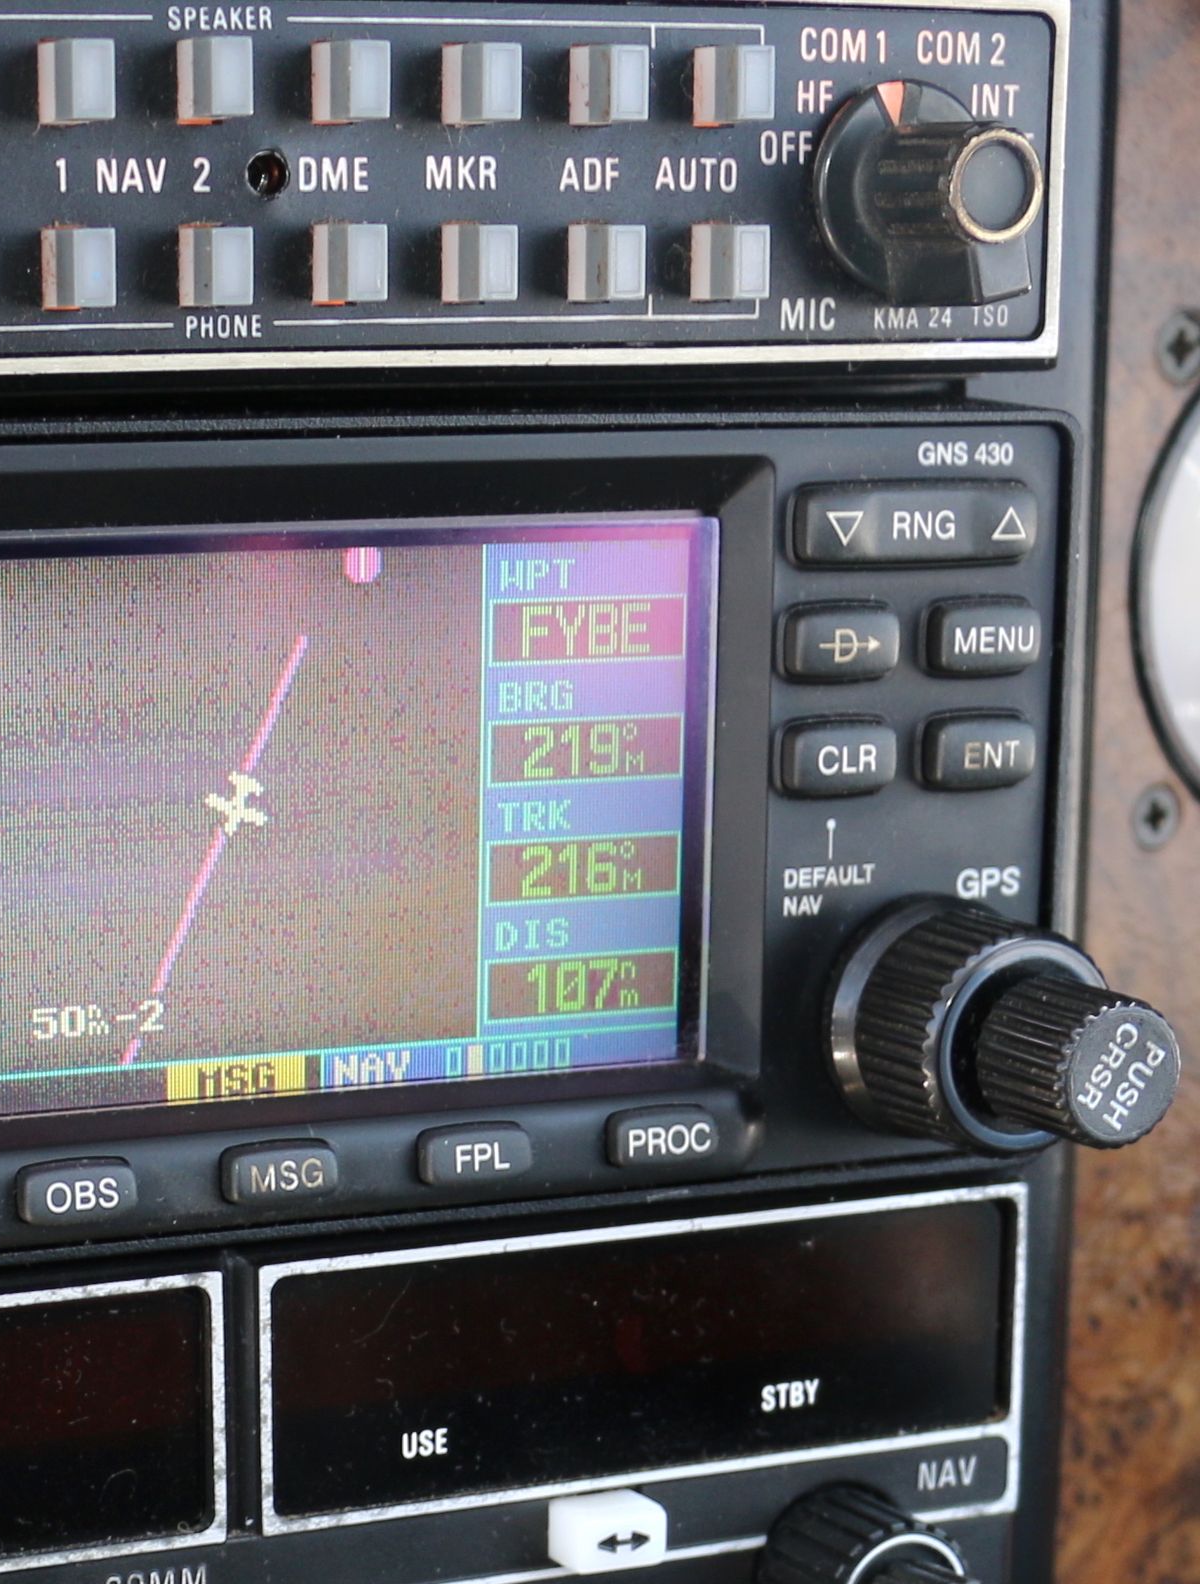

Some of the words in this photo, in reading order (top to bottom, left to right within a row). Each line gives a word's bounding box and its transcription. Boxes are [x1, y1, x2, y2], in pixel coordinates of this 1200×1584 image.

[168, 6, 273, 32] SPEAKER
[800, 27, 867, 63] COM
[877, 31, 888, 63] 1
[916, 31, 983, 64] COM
[989, 33, 1006, 64] 2
[797, 80, 834, 114] HF
[971, 83, 1020, 117] INT
[760, 131, 813, 165] OFF
[55, 158, 68, 192] 1
[96, 158, 167, 193] NAV
[192, 158, 212, 192] 2
[299, 157, 369, 192] DME
[425, 156, 498, 190] MKR
[560, 158, 620, 193] ADF
[655, 157, 738, 193] AUTO
[185, 315, 263, 339] PHONE
[780, 298, 836, 331] MIC
[873, 308, 918, 329] KMA
[929, 308, 952, 328] 24
[918, 441, 968, 467] GNS
[975, 443, 1014, 466] 430
[892, 510, 956, 540] RNG
[500, 558, 575, 592] WPT
[522, 602, 650, 658] FYBE
[954, 625, 1034, 655] MENU
[498, 680, 573, 713] BRG
[818, 744, 877, 776] CLR
[964, 740, 1020, 770] ENT
[497, 800, 572, 833] TRK
[783, 864, 875, 890] DEFAULT
[956, 866, 1021, 899] GPS
[783, 895, 823, 916] NAV
[495, 918, 570, 952] DIS
[197, 1062, 277, 1099] MSG
[333, 1050, 410, 1089] NAV
[1077, 1022, 1139, 1111] CRSR
[1103, 1040, 1166, 1131] PUSH
[628, 1123, 711, 1158] PROC
[455, 1142, 511, 1174] FPL
[251, 1159, 325, 1194] MSG
[46, 1178, 119, 1214] OBS
[760, 1378, 819, 1413] STBY
[402, 1428, 448, 1459] USE
[918, 1456, 977, 1491] NAV
